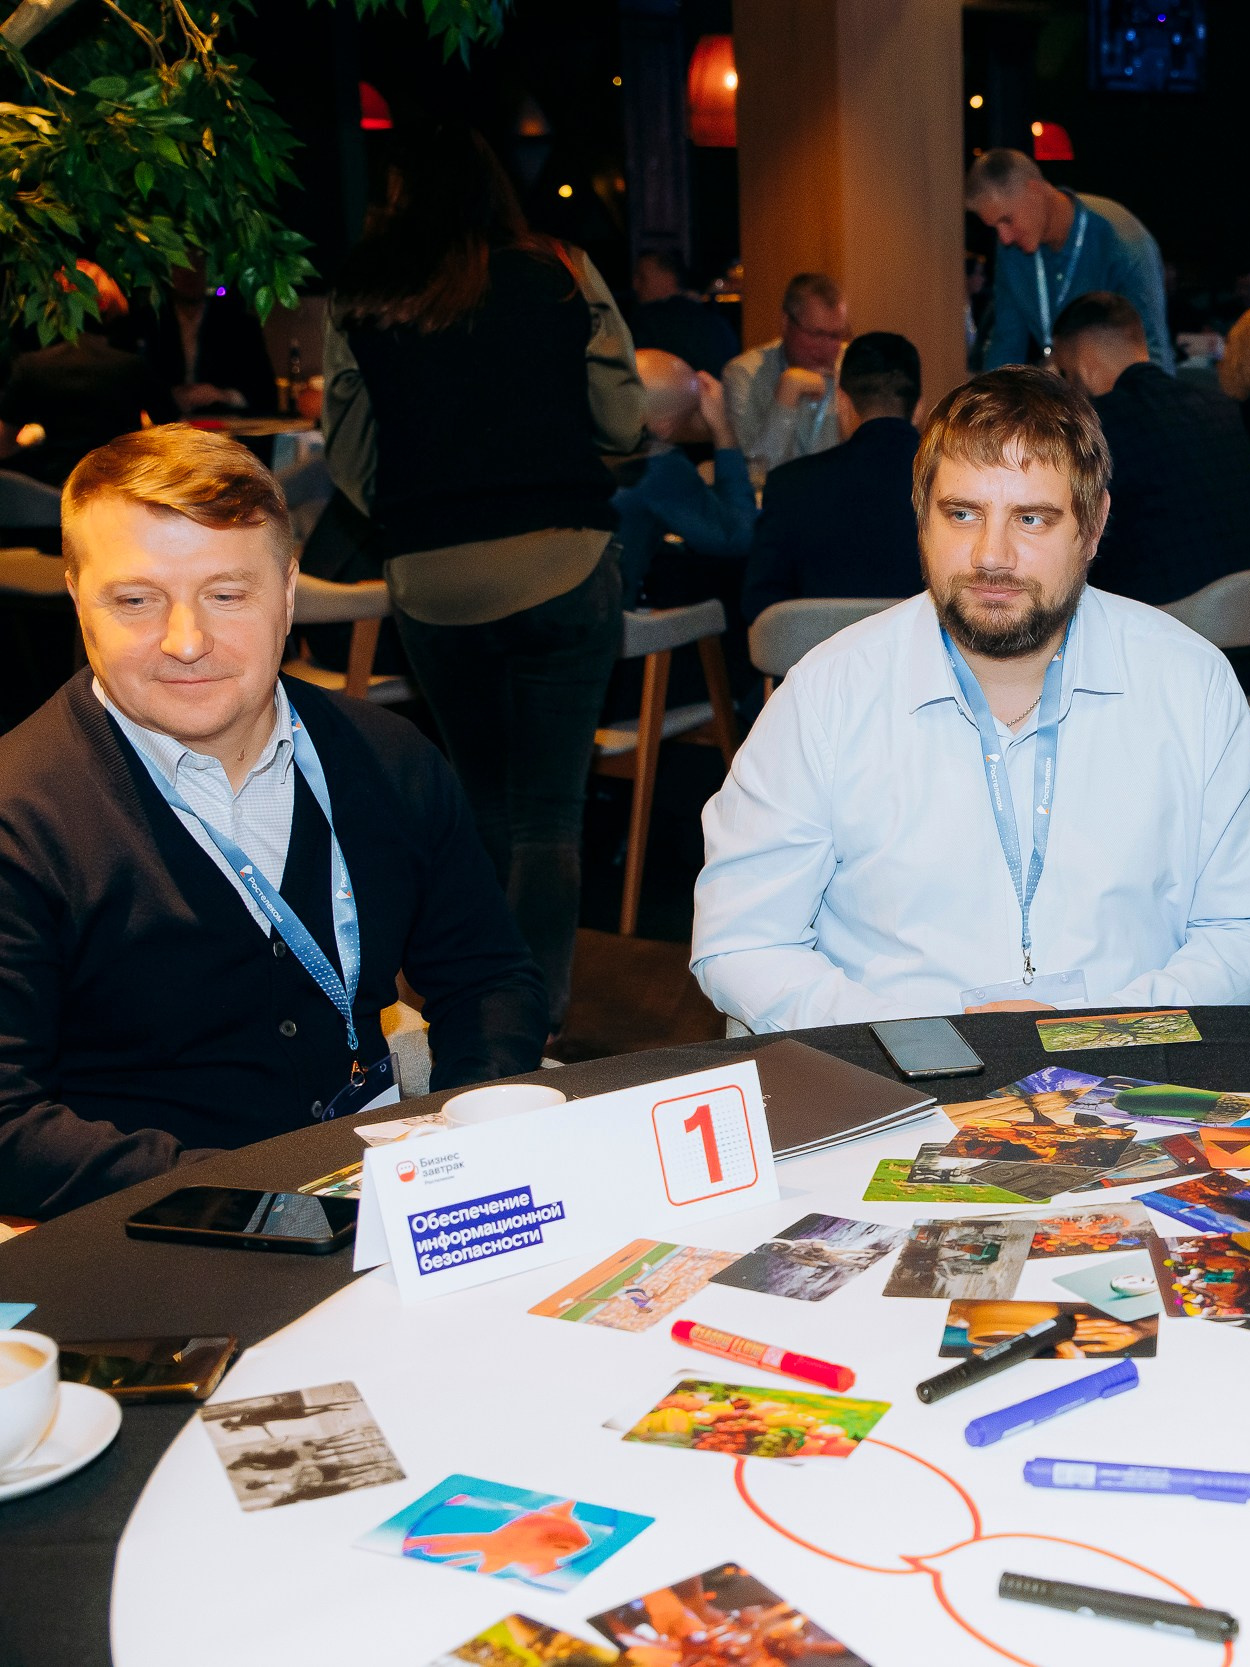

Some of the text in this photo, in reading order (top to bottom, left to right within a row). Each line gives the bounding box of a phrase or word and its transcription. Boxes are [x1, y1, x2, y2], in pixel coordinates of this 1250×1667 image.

[989, 764, 1003, 812] Ростелеком
[1042, 757, 1052, 805] Ростелеком
[247, 876, 284, 924] Ростелеком
[419, 1152, 460, 1168] Бизнес
[684, 1103, 723, 1184] 1
[422, 1161, 465, 1177] завтрак
[411, 1193, 530, 1233] Обеспечение
[416, 1202, 562, 1253] информационной
[420, 1229, 541, 1271] безопасности
